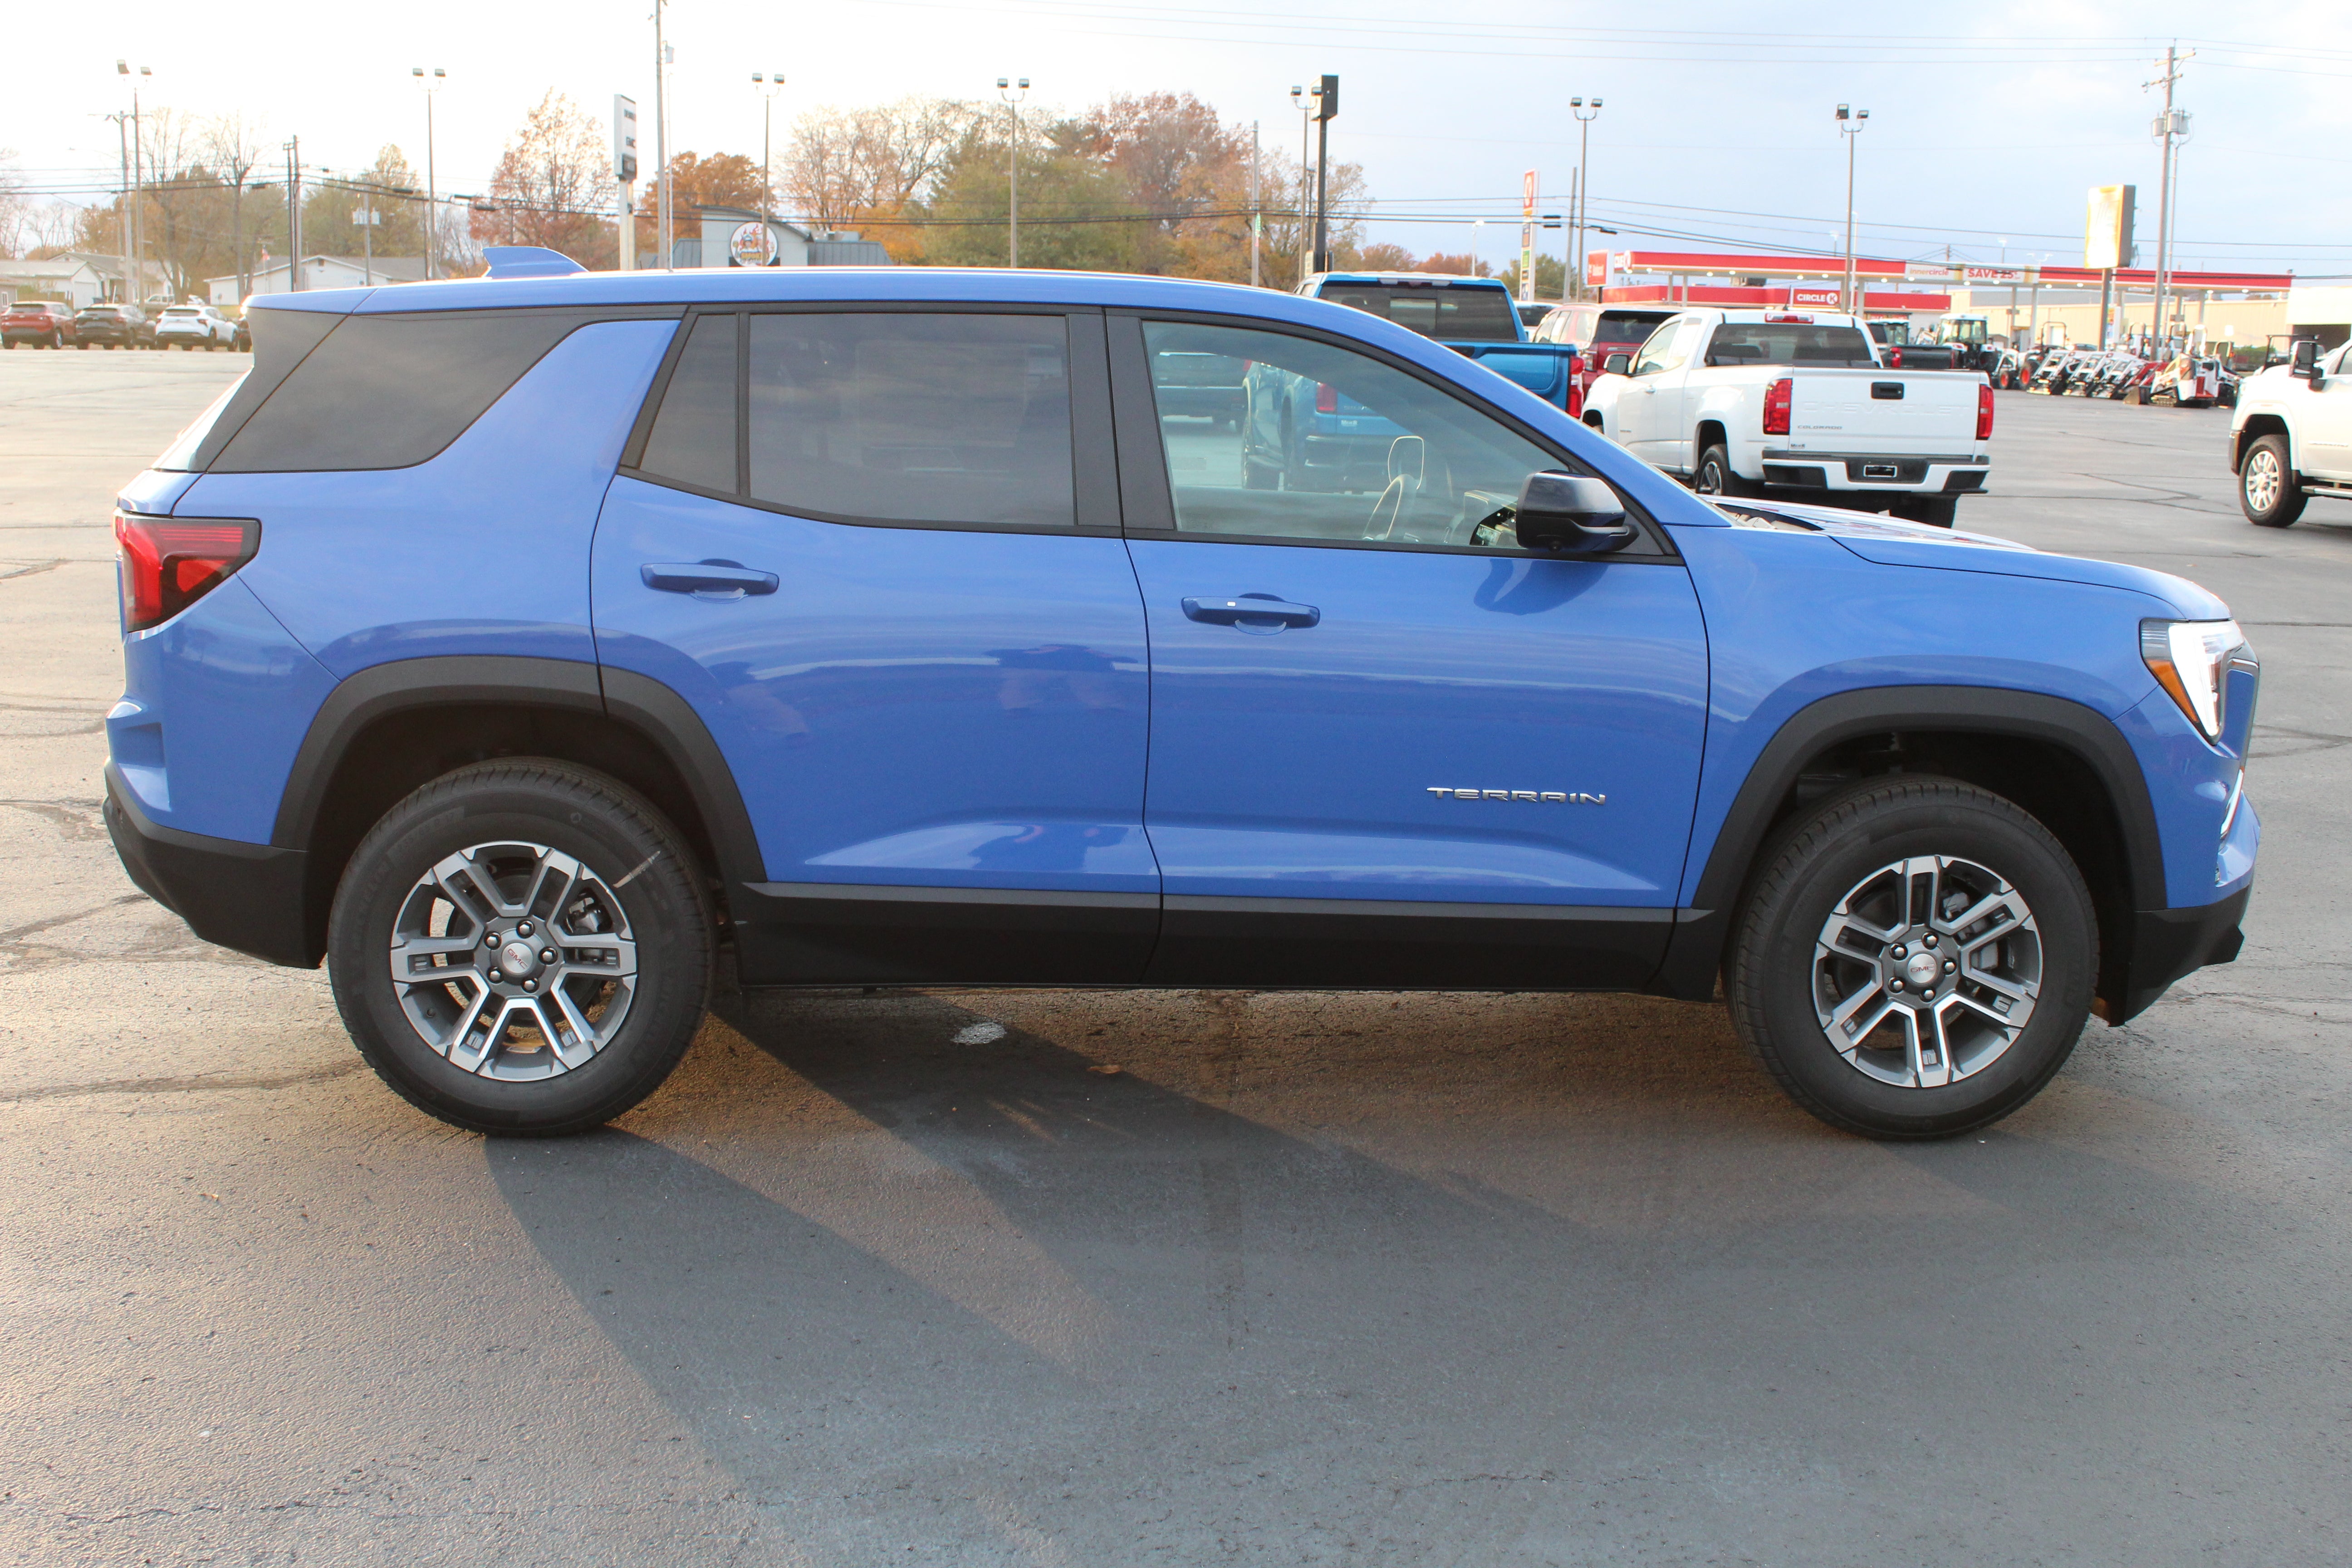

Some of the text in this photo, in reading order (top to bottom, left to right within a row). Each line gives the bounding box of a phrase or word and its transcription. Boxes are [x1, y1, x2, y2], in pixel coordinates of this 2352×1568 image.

[1910, 267, 1949, 276] innercircle
[1968, 268, 1997, 279] SAVE
[1797, 293, 1838, 305] CIRCLE K
[1426, 787, 1606, 805] TERRAIN
[508, 948, 528, 970] GMC
